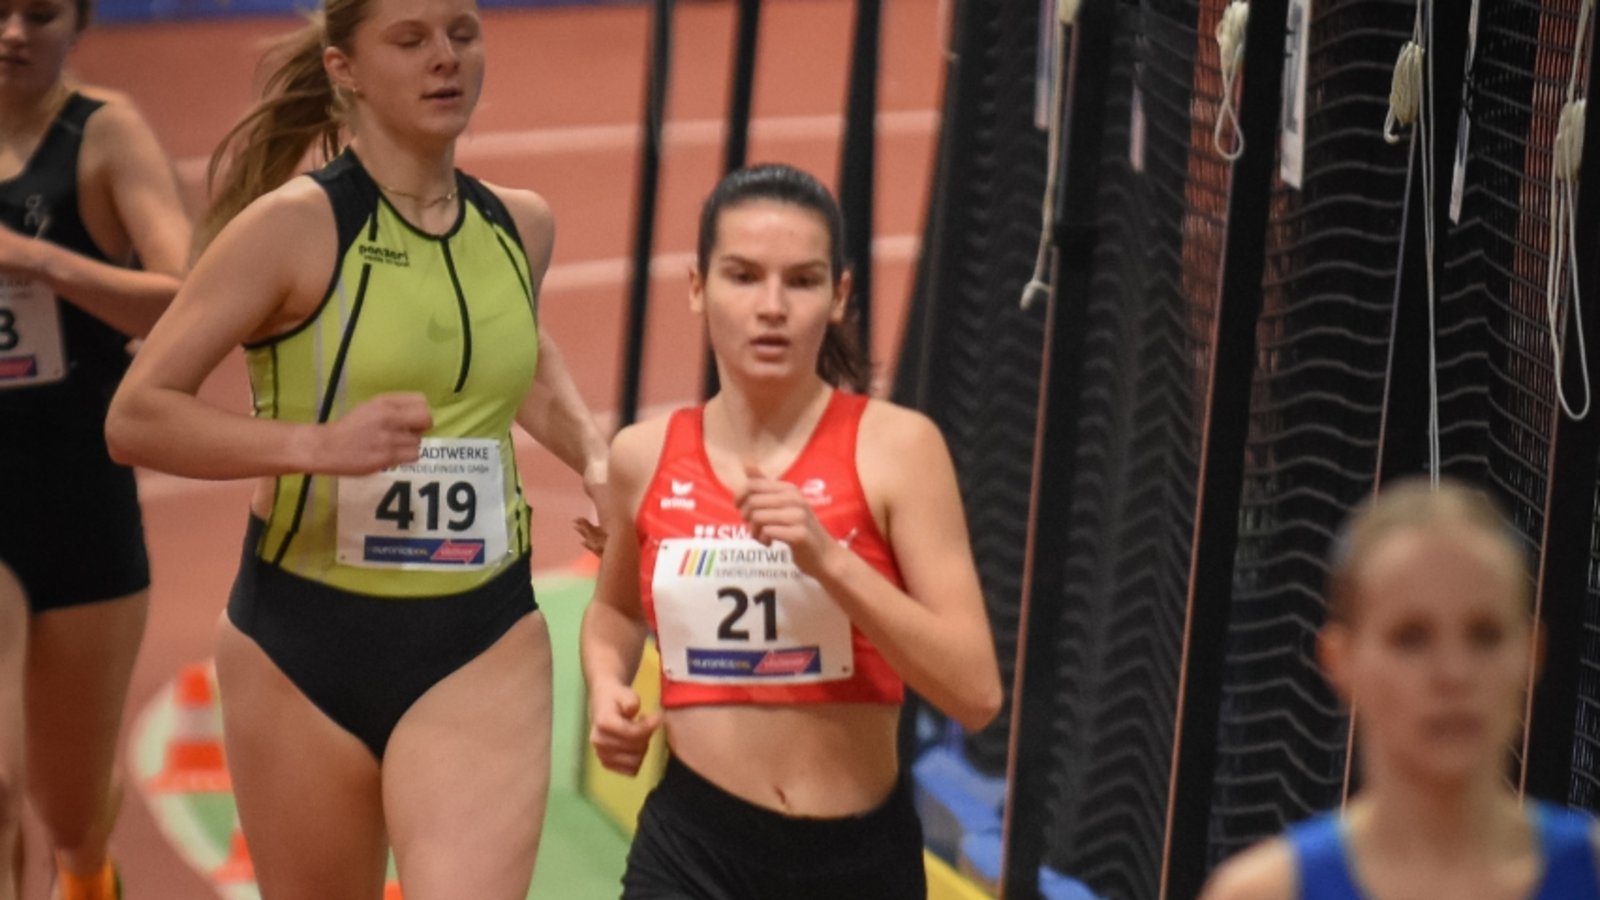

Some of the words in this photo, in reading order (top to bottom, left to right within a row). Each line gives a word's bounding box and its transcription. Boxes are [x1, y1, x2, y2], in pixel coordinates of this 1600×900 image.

[417, 446, 489, 460] ADTWERKE
[375, 480, 477, 532] 419
[719, 549, 788, 563] STADTWE
[717, 587, 778, 642] 21
